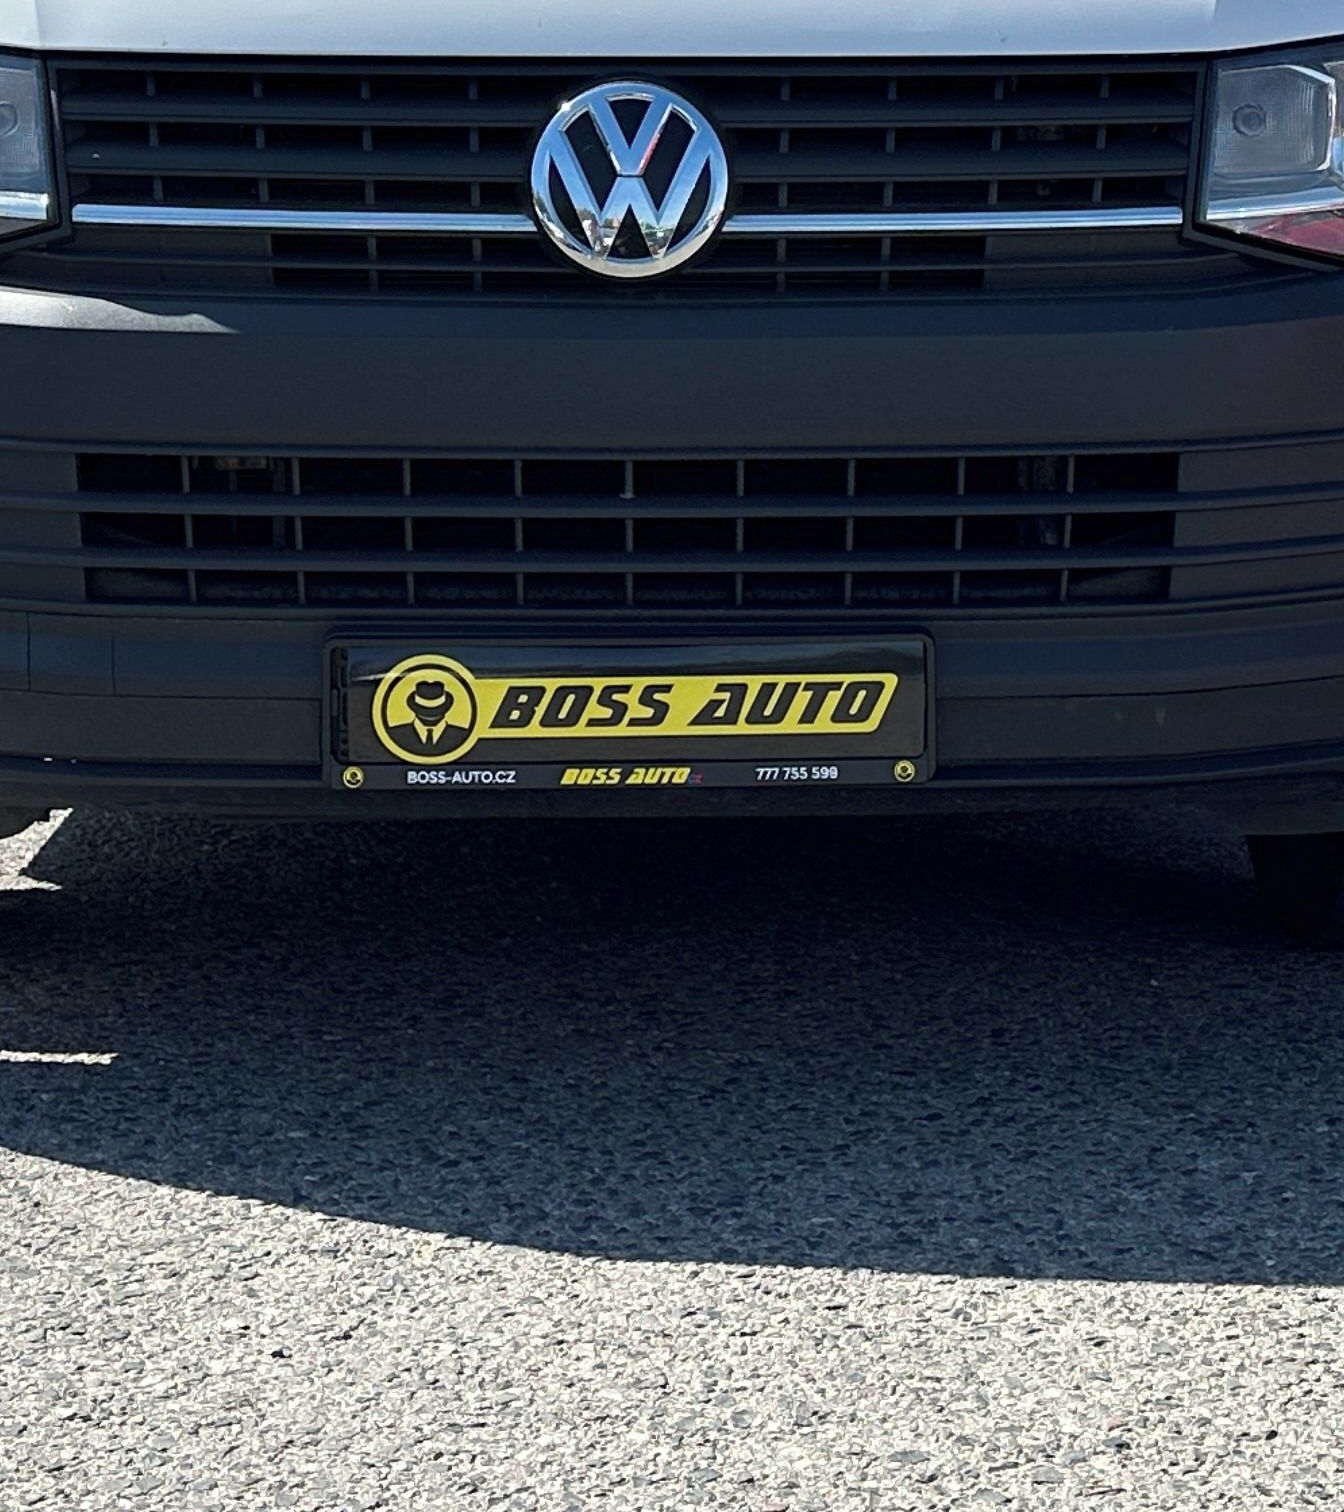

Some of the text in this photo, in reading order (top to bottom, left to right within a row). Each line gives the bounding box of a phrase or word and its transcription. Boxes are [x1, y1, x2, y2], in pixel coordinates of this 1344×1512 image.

[488, 680, 888, 729] BOSS AUTO
[406, 770, 516, 785] BOSS-AUTO.CZ
[559, 768, 623, 786] BOSS
[755, 767, 780, 781] 777
[783, 766, 808, 780] 755
